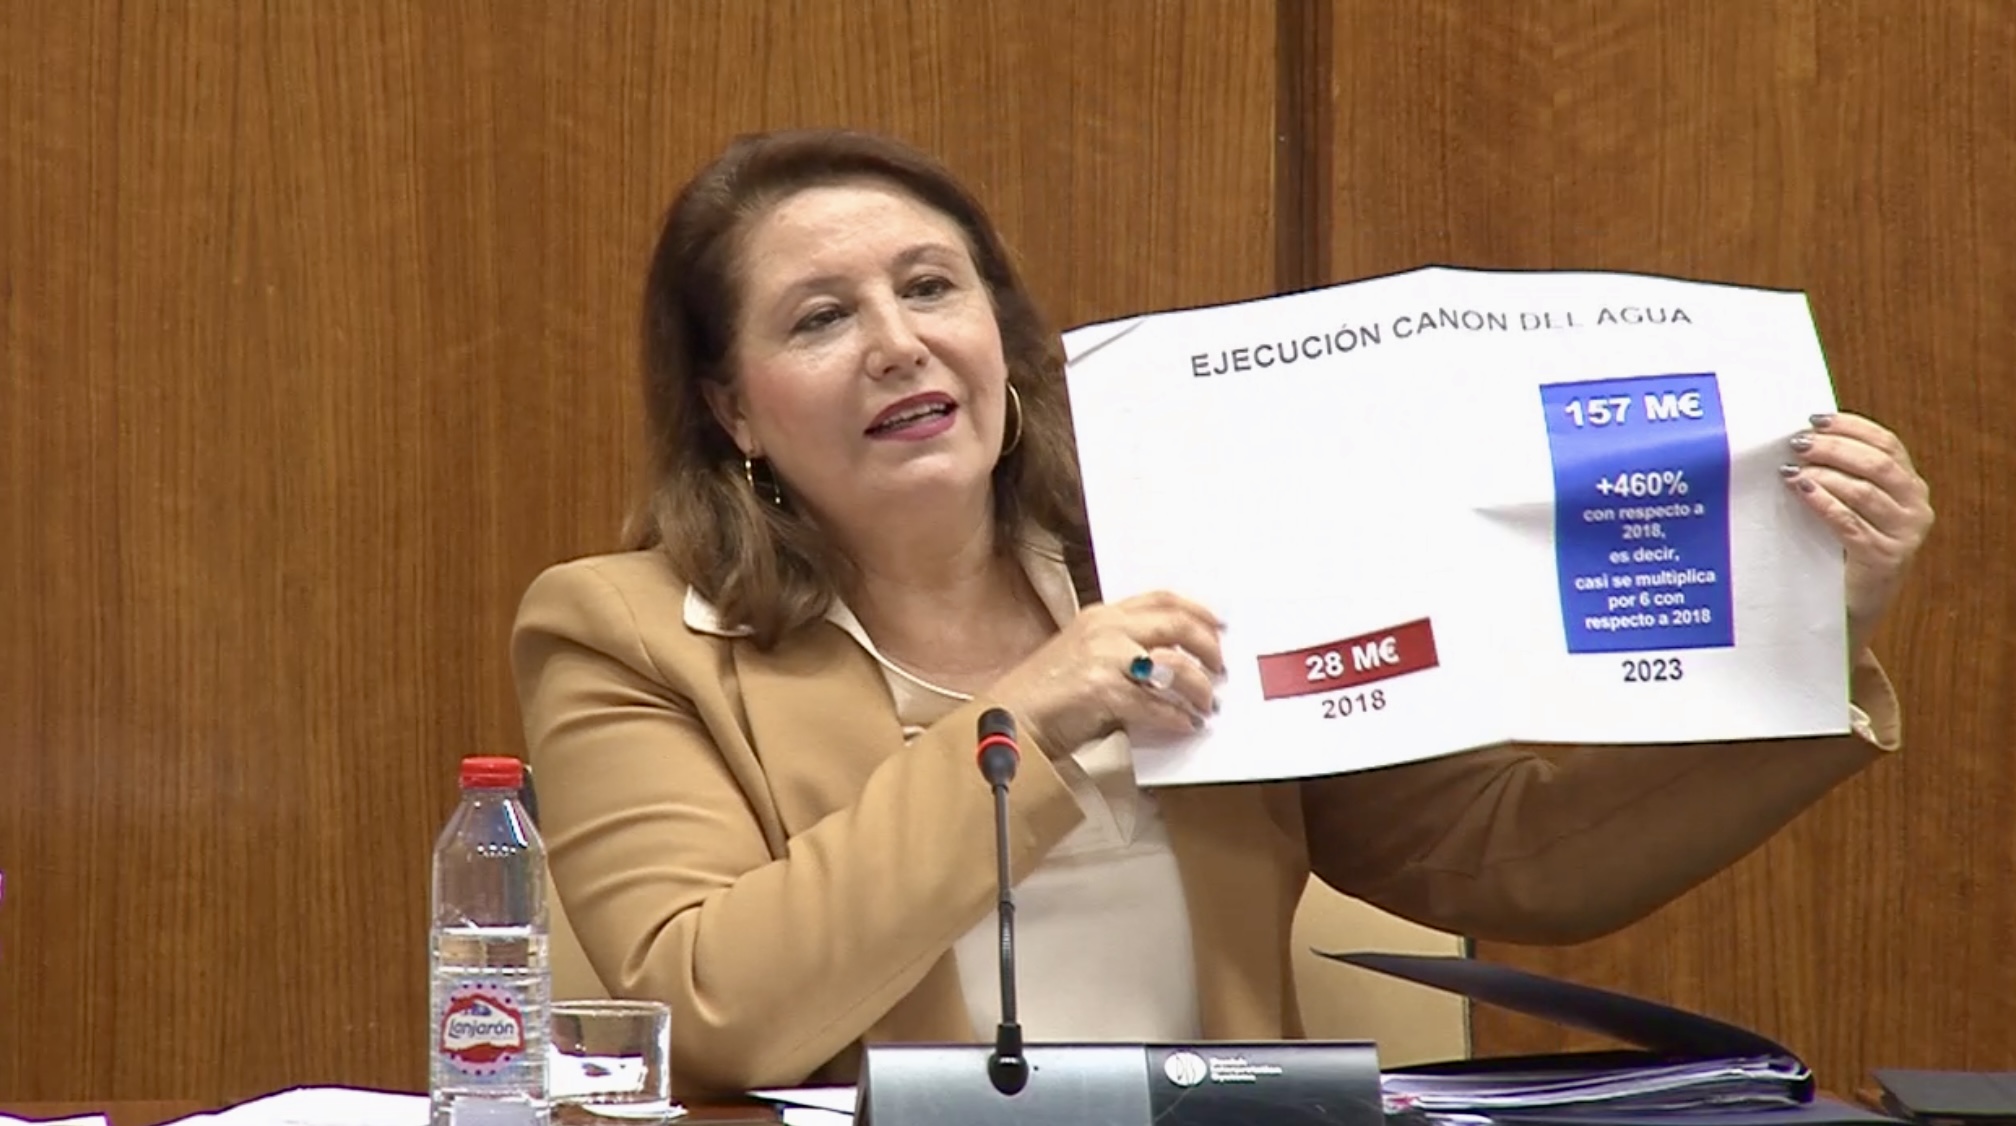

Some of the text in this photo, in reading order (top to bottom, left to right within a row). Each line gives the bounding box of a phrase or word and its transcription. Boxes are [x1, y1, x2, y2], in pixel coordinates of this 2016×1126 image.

[1191, 323, 1381, 377] EJECUCIÓN
[1392, 307, 1507, 338] CANON
[1597, 307, 1692, 325] AGUA
[1564, 390, 1703, 426] 157 M€
[1596, 470, 1688, 498] +460%
[1583, 503, 1704, 522] con respecto a
[1622, 523, 1666, 539] 2018,
[1609, 546, 1680, 564] es decir,
[1575, 568, 1716, 590] casi se multiplica
[1608, 591, 1684, 611] por 6 con
[1585, 608, 1712, 632] respecto a 2018
[1305, 636, 1399, 681] 28 M€
[1622, 657, 1683, 682] 2023
[1322, 689, 1387, 719] 2018
[448, 1018, 515, 1039] Lanjarón
